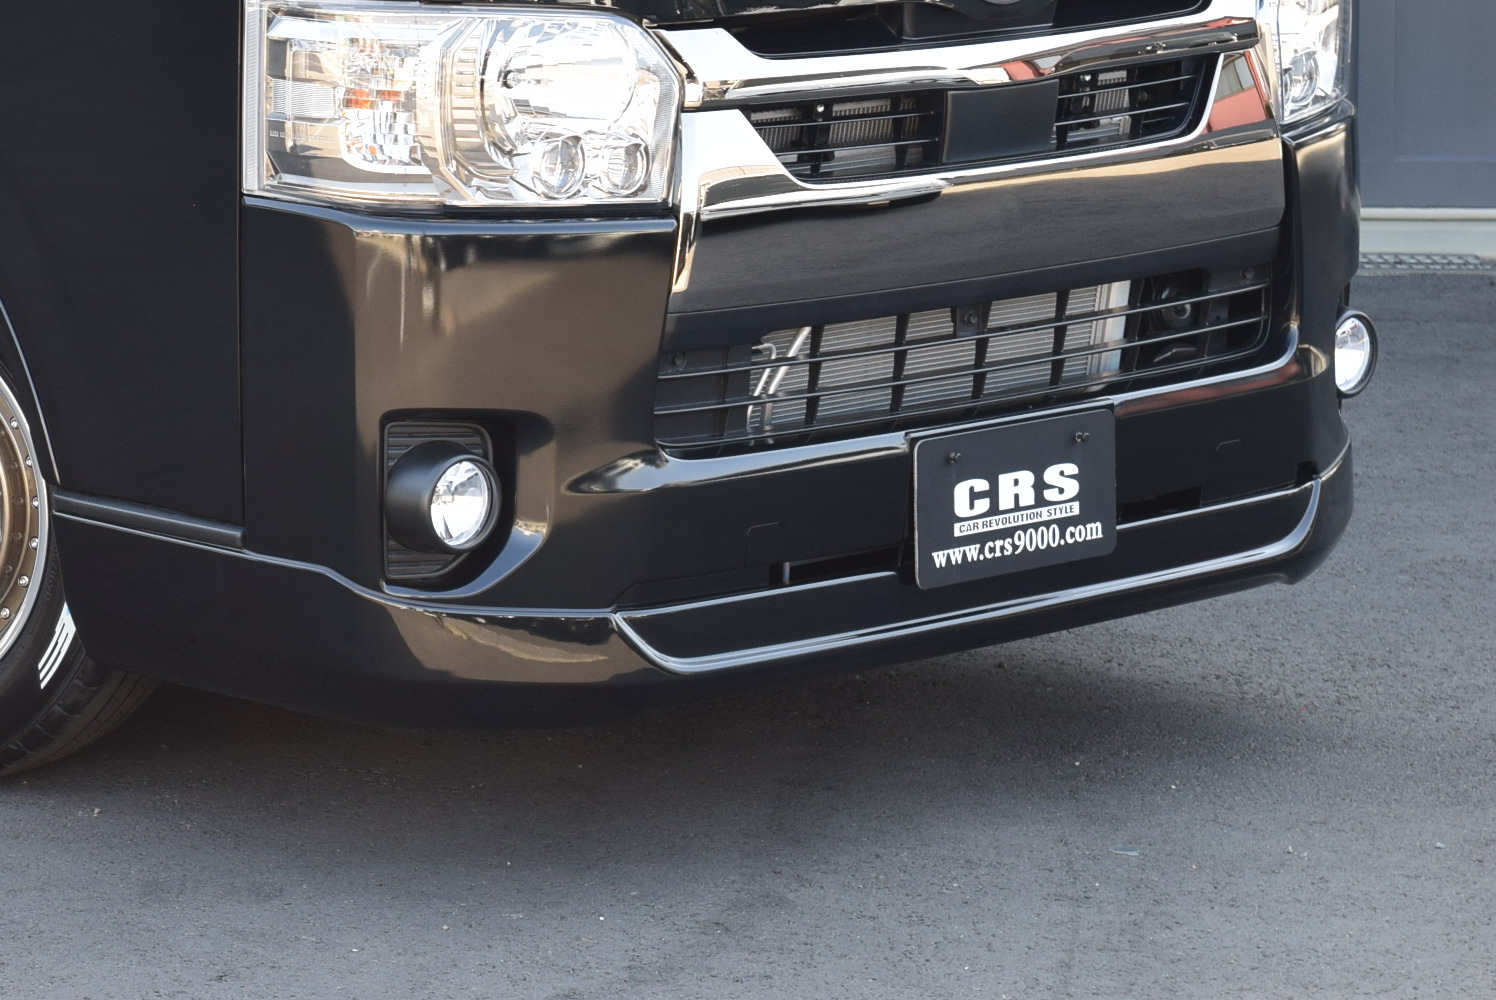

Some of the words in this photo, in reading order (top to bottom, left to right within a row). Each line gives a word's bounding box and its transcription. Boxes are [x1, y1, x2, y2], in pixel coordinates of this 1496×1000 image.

[954, 463, 1079, 518] CRS
[959, 521, 980, 534] CAR
[982, 510, 1043, 530] REVOLUTION
[1046, 504, 1075, 518] STYLE
[931, 521, 1104, 569] www.crs9000.com
